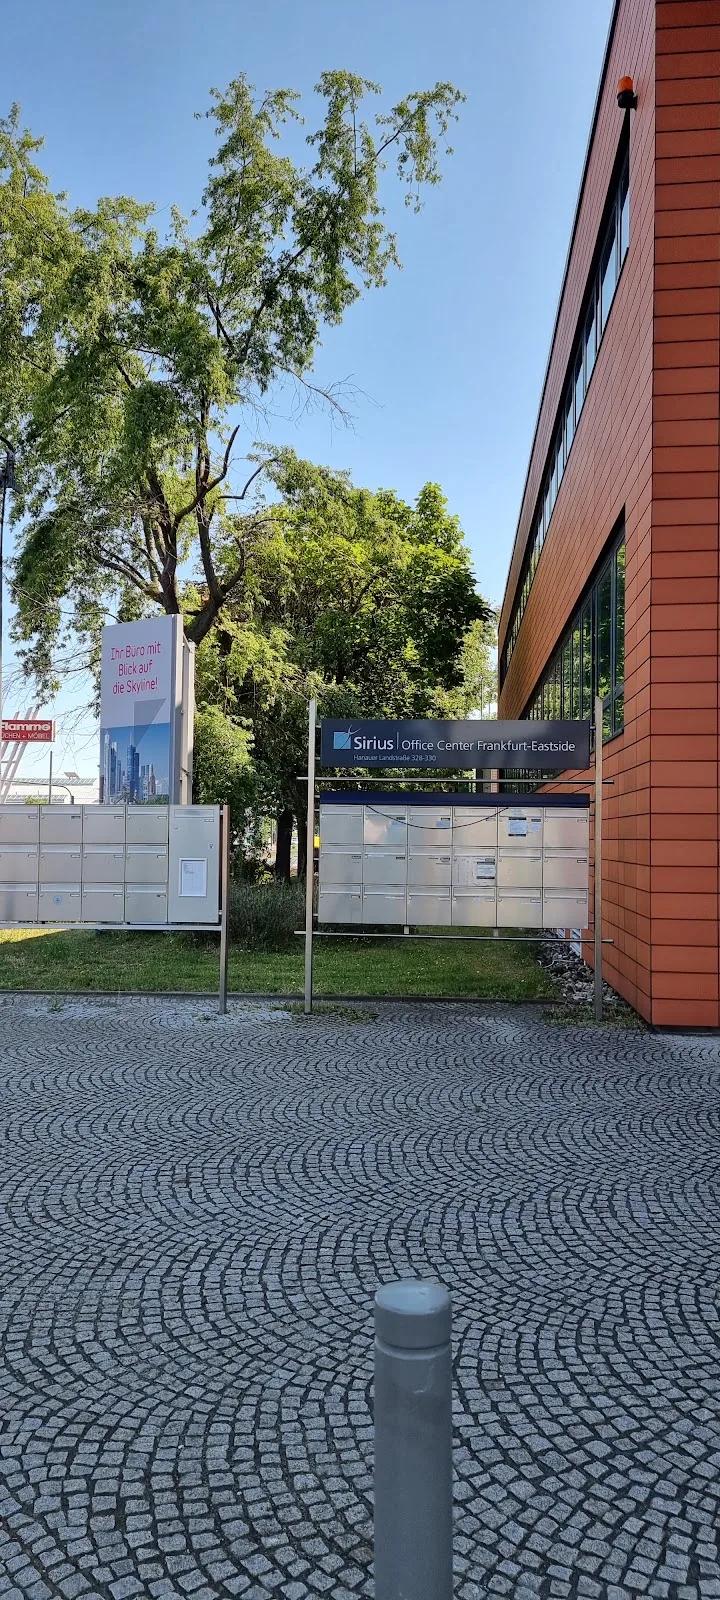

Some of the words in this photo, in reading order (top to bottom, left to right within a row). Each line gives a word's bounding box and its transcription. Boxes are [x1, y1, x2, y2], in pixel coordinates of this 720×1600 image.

[111, 647, 124, 660] Ihr
[125, 644, 145, 658] Büro
[147, 641, 161, 655] mit
[118, 662, 137, 677] Blick
[139, 659, 153, 674] auf
[112, 682, 124, 694] die
[126, 676, 158, 694] Skyline!
[353, 736, 394, 750] Sirius
[401, 739, 434, 751] Office
[436, 740, 474, 751] Center
[477, 739, 576, 752] Frankfurt-Eastside
